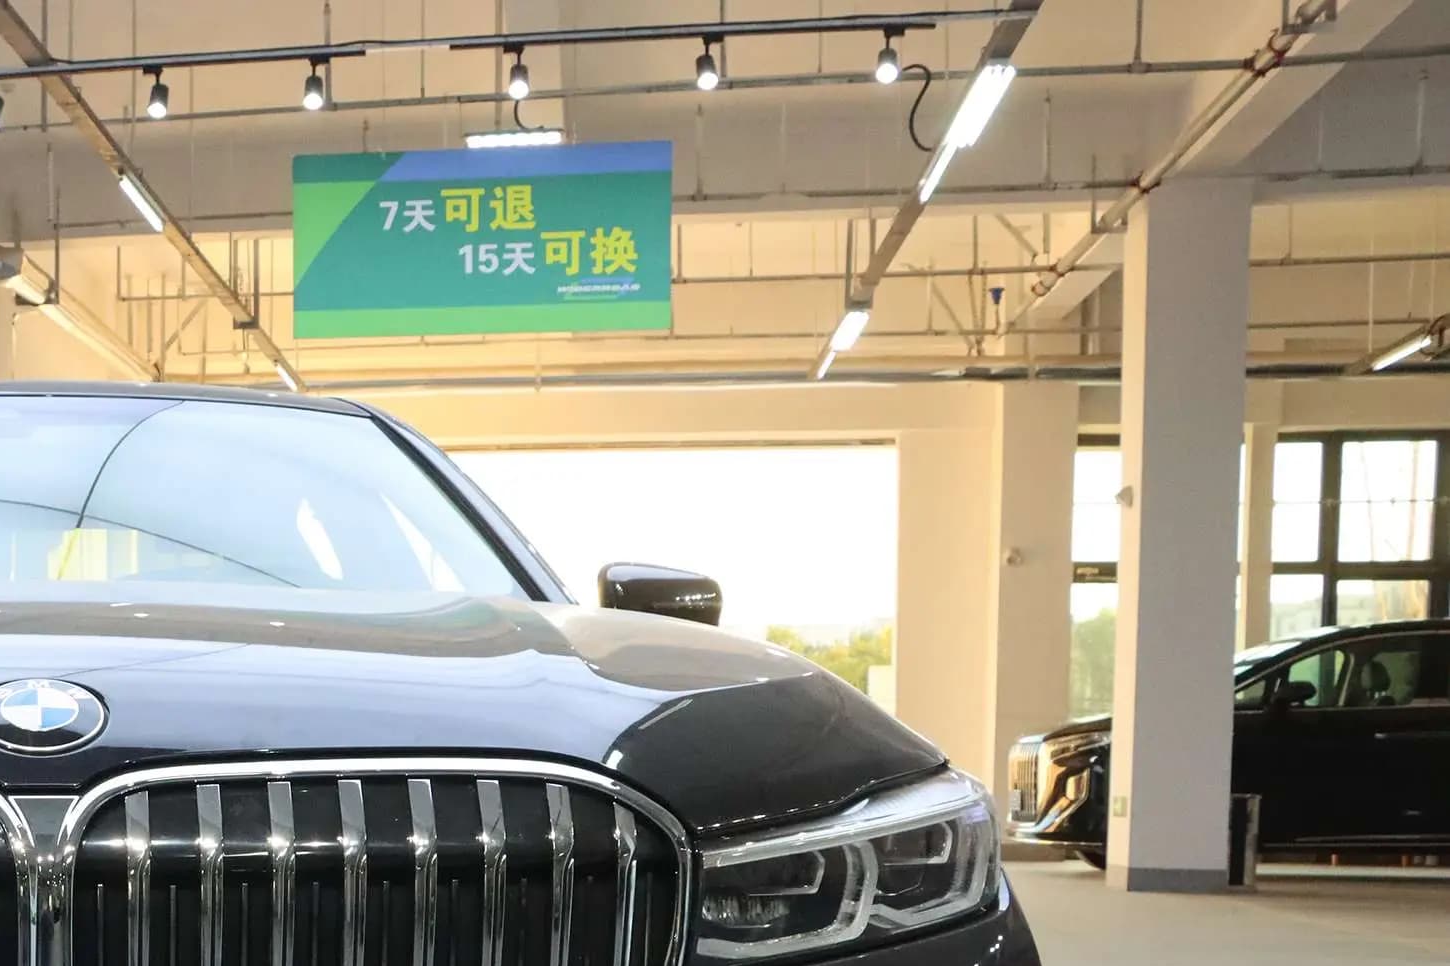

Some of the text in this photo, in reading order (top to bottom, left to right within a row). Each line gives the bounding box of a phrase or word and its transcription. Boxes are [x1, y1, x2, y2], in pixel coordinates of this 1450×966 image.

[379, 185, 535, 232] 7天可退
[458, 227, 638, 275] 15天可换
